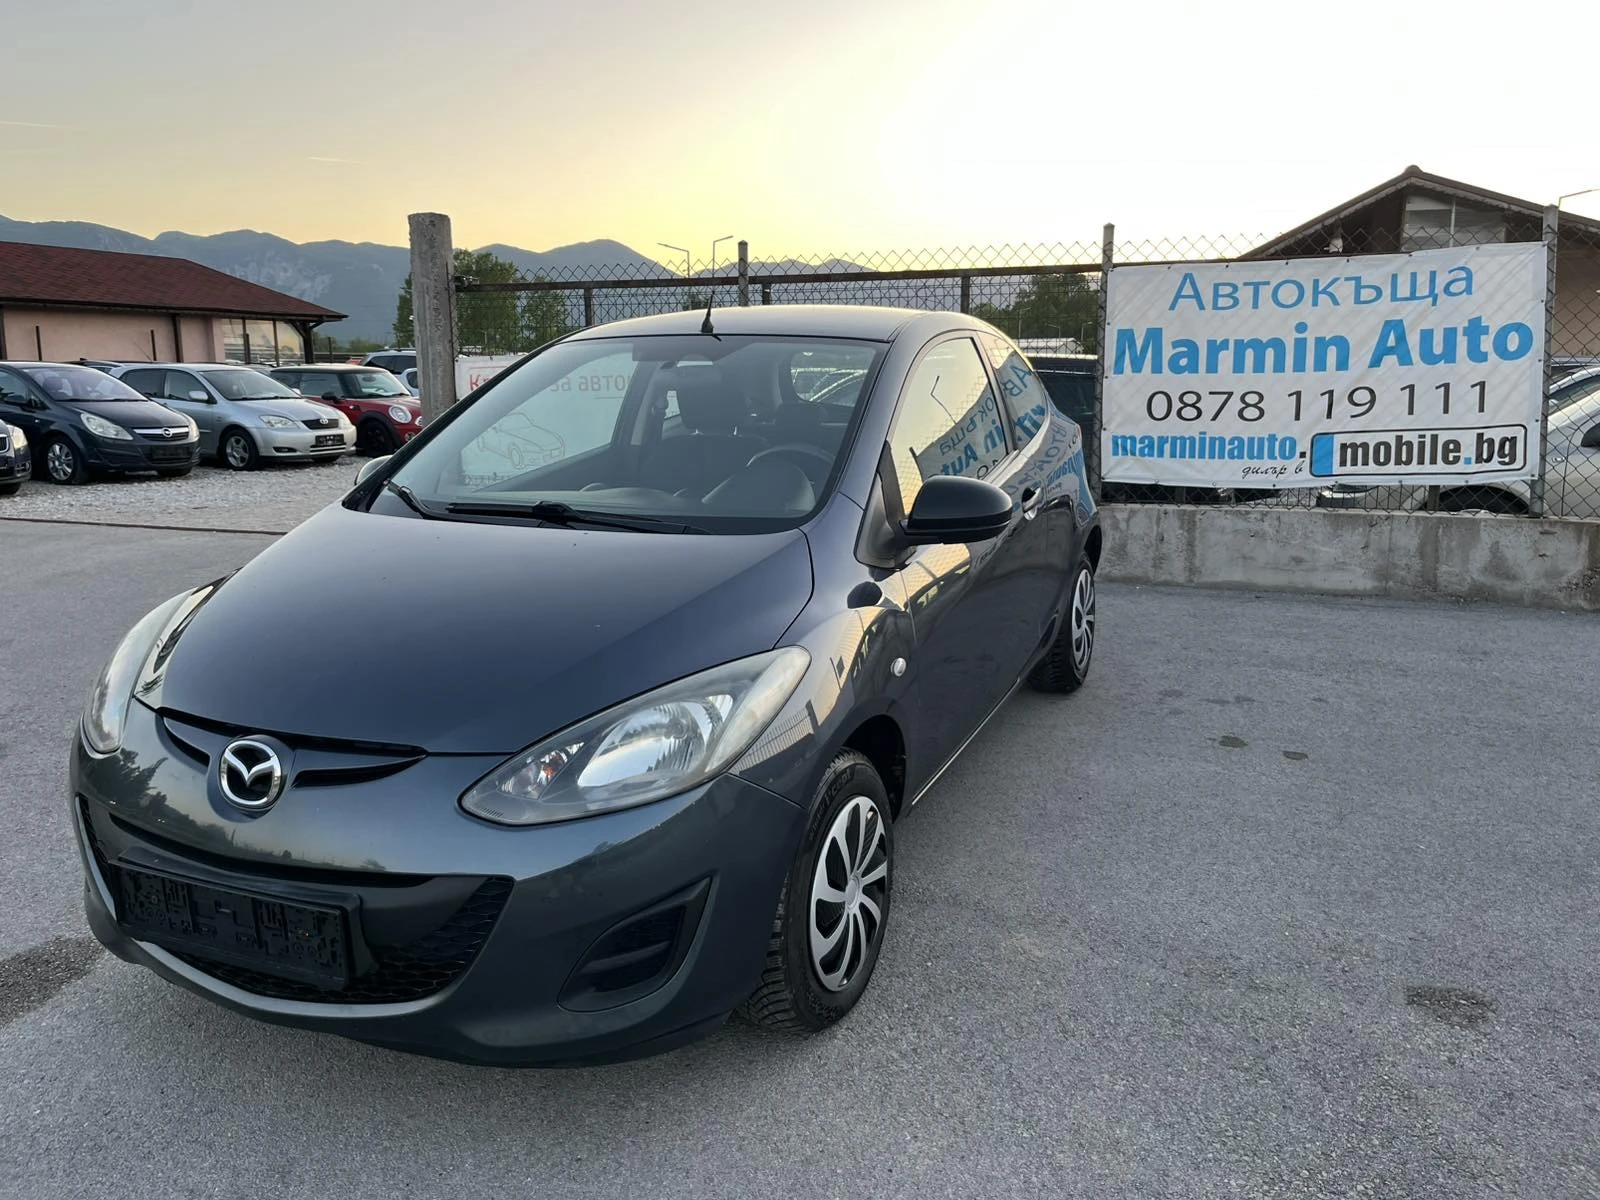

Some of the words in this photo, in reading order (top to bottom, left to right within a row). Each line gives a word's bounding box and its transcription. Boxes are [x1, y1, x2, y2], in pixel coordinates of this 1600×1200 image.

[1168, 265, 1473, 311] Автокъща
[1113, 321, 1350, 375] Marmin
[1368, 315, 1534, 369] Auto
[1146, 390, 1265, 422] 0878
[1287, 385, 1377, 421] 119
[1400, 380, 1486, 416] 111
[1339, 432, 1518, 468] mobile.bg
